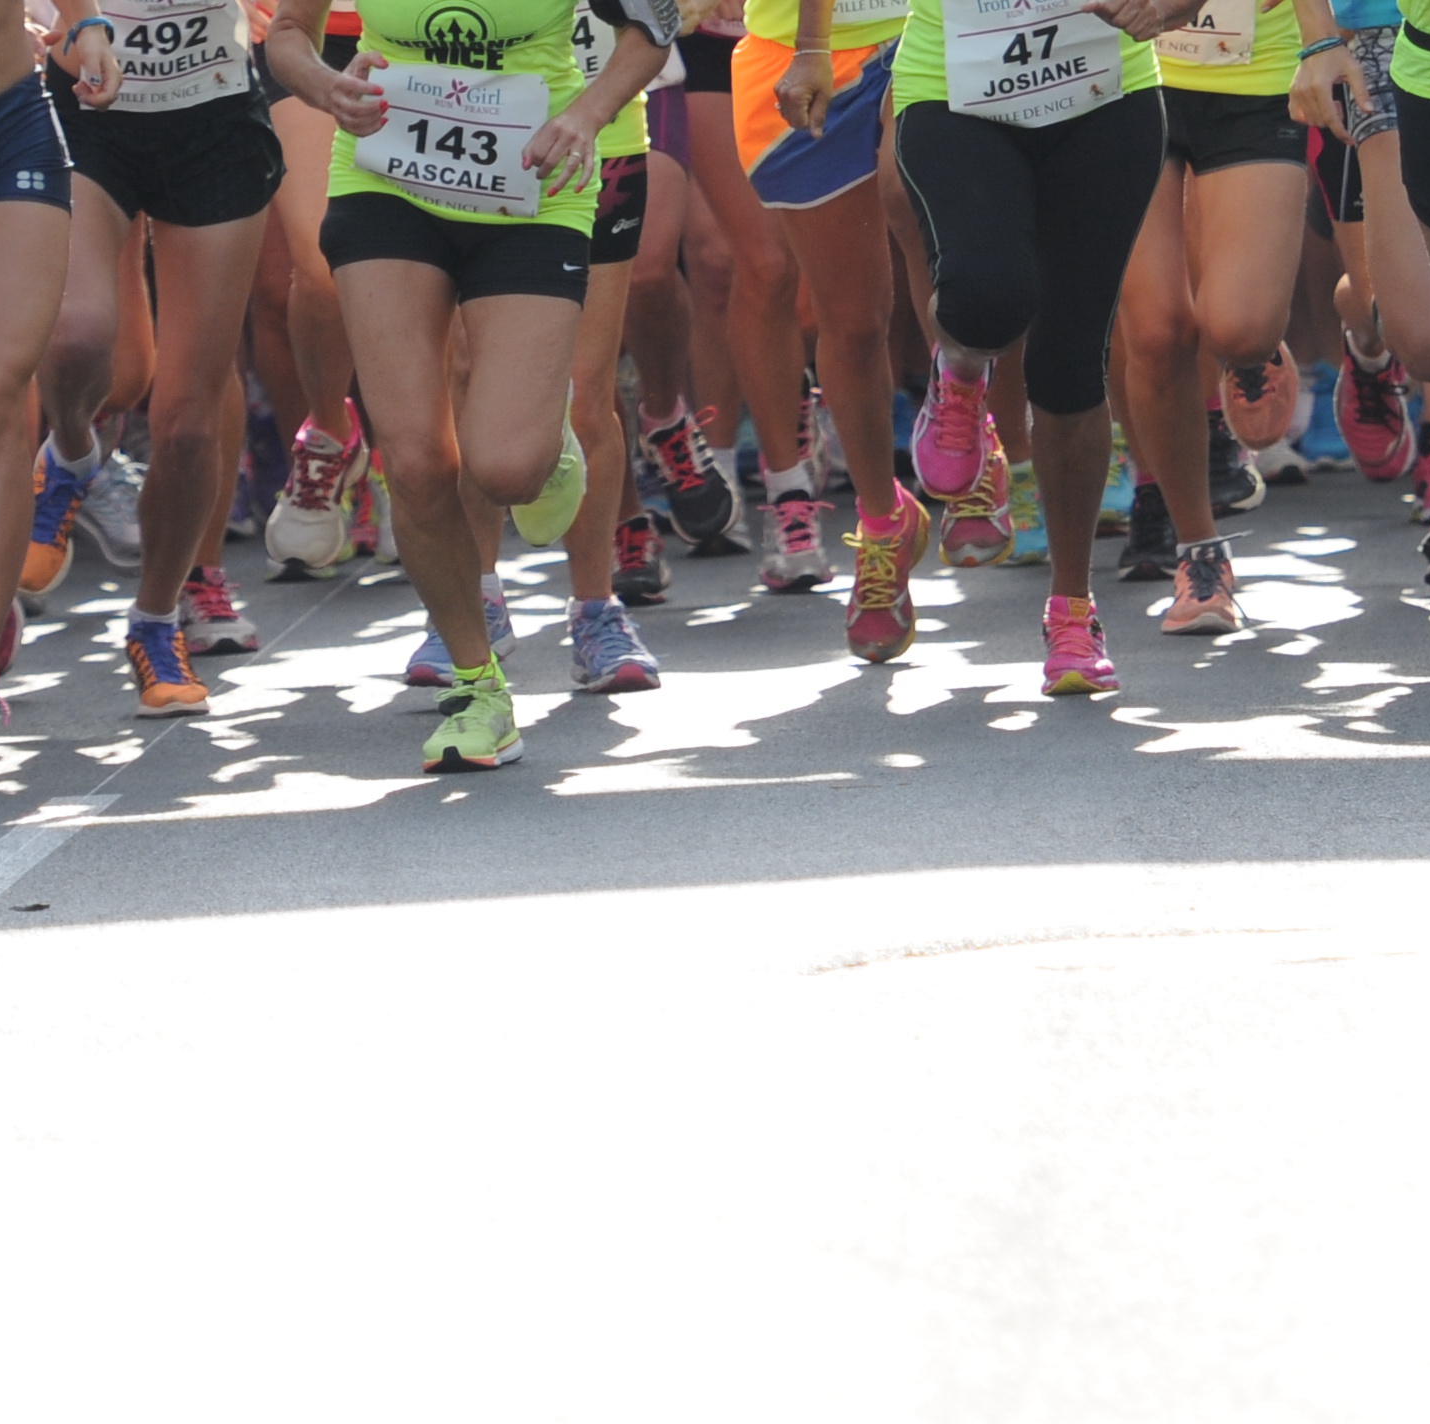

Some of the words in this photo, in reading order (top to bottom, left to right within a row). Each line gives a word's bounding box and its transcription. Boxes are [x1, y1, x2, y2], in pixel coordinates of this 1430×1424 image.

[832, 0, 868, 14] VILLE
[1006, 10, 1024, 19] RUN
[1035, 0, 1069, 13] FRANCE
[125, 15, 209, 56] 492
[1002, 24, 1059, 66] 47
[1168, 40, 1201, 54] NICE
[116, 46, 229, 77] ANUELLA
[425, 43, 504, 71] NICE
[406, 75, 443, 97] Iron
[466, 87, 503, 106] Girl
[983, 56, 1088, 97] JOSIANE
[117, 91, 147, 104] ILLE
[150, 90, 168, 103] DE
[171, 83, 200, 100] NICE
[434, 99, 453, 109] RUN
[464, 106, 500, 116] FRANCE
[1023, 104, 1041, 120] DE
[1044, 96, 1075, 114] NICE
[407, 118, 499, 166] 143
[387, 157, 506, 193] PASCALE
[424, 195, 441, 207] DE
[446, 199, 480, 213] NICE
